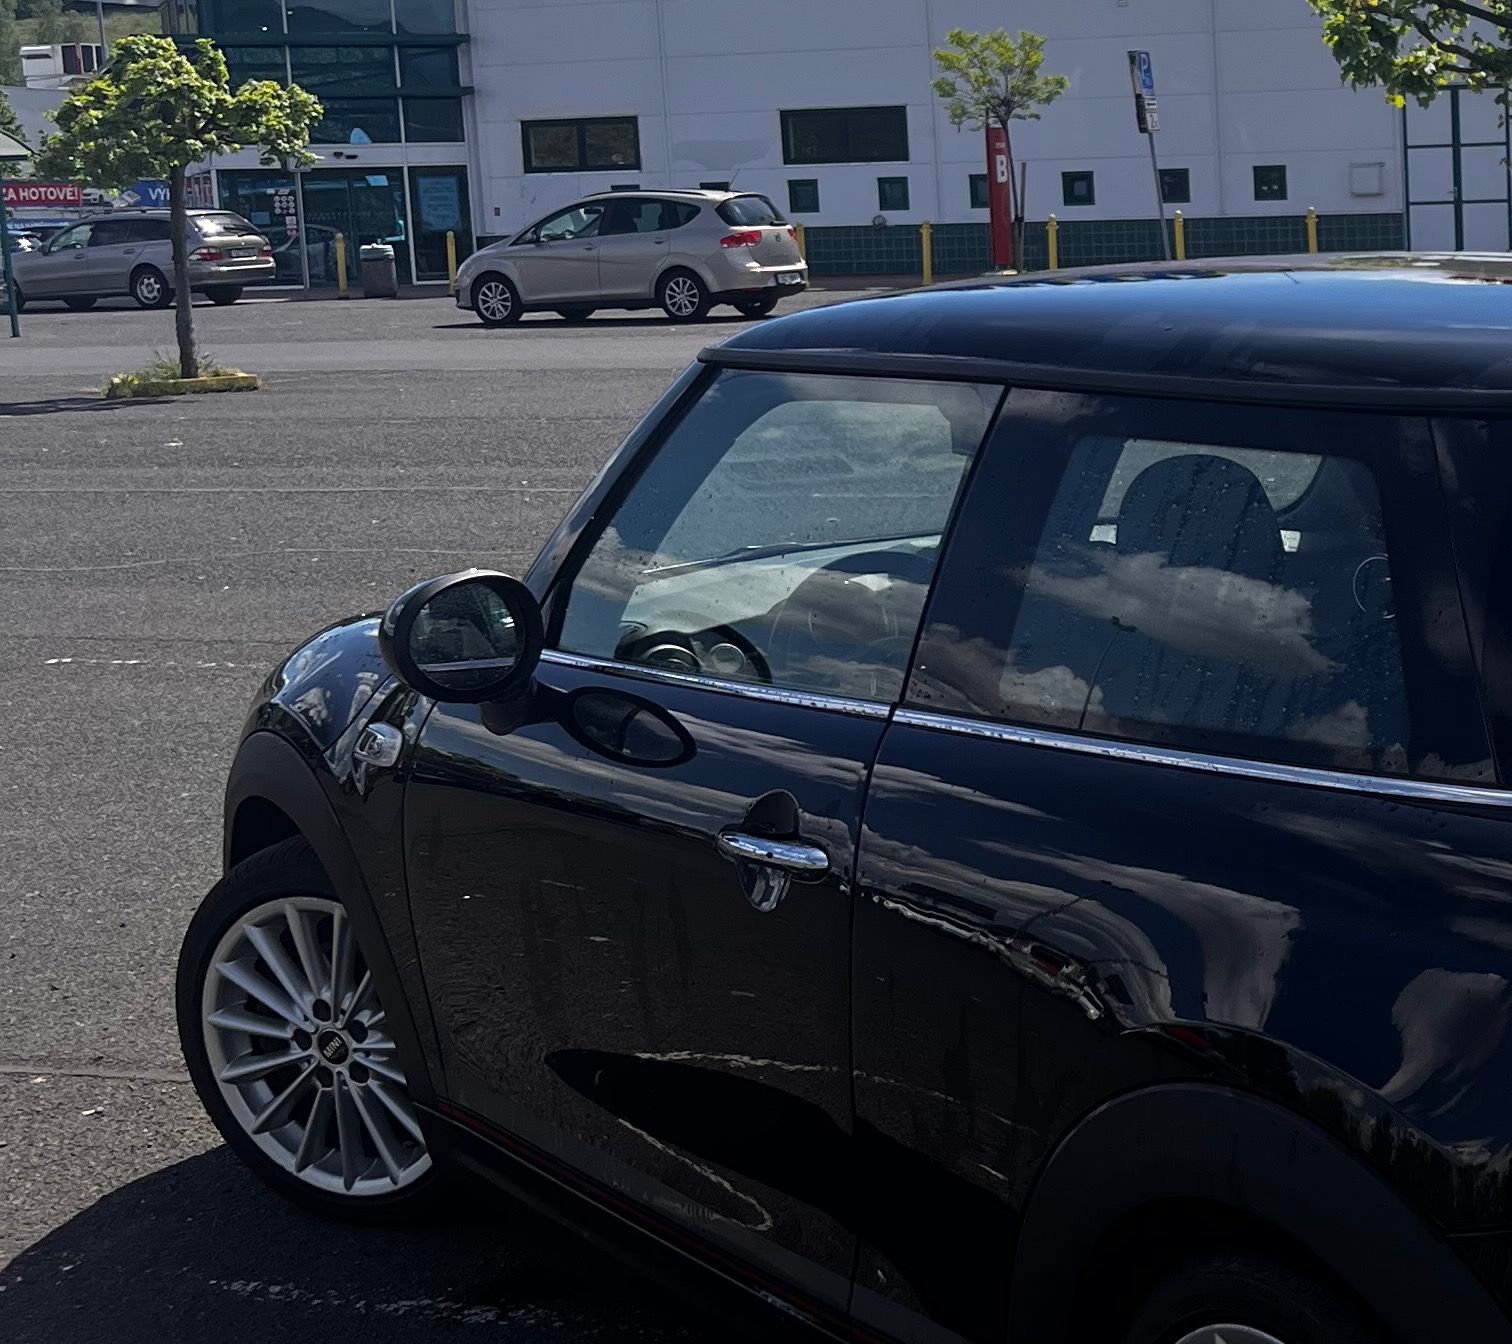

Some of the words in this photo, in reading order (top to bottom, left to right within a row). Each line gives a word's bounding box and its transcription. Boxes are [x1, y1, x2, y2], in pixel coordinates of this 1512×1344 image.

[996, 154, 1008, 183] B
[18, 184, 79, 201] HOTOVÉ!
[322, 1036, 342, 1058] MINI
